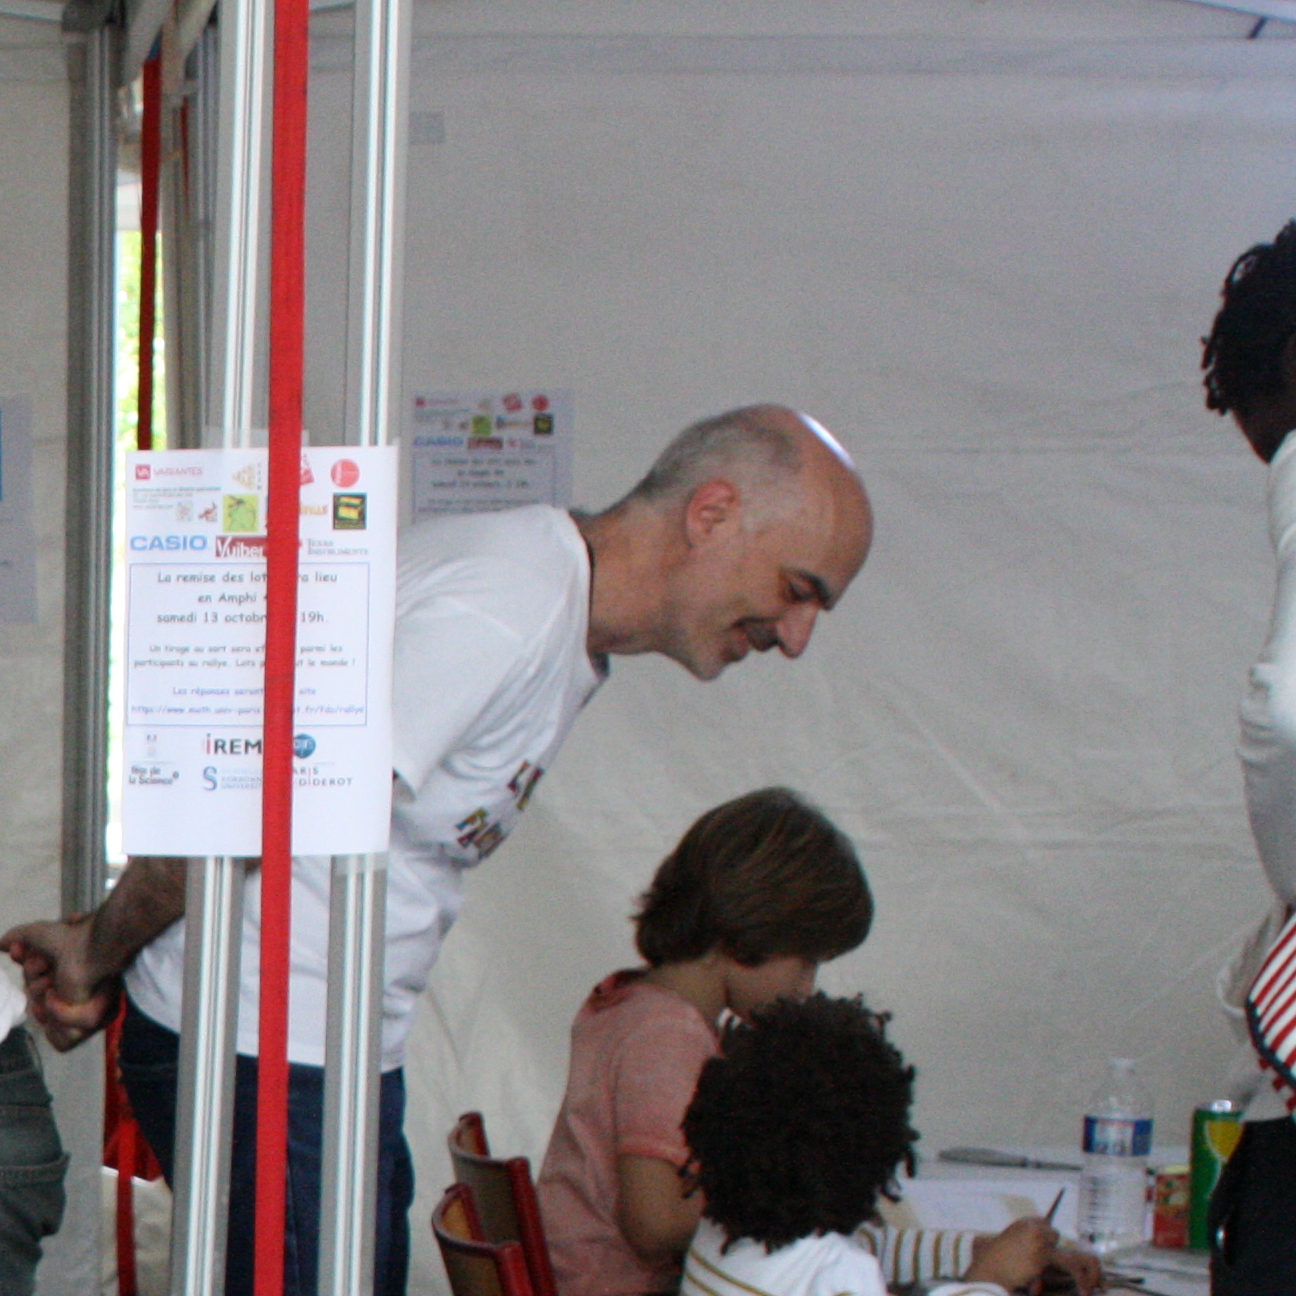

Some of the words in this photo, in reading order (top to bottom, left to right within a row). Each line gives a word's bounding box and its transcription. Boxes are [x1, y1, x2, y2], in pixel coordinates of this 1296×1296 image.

[130, 535, 208, 552] CASIO
[216, 536, 268, 558] Vuiber
[157, 571, 172, 584] La
[176, 571, 216, 583] remise
[222, 571, 244, 583] des
[250, 571, 268, 583] lot
[315, 571, 338, 583] lieu
[197, 593, 213, 603] en
[218, 591, 257, 606] Amphi
[157, 611, 197, 623] samedi
[203, 611, 219, 623] 13
[224, 611, 268, 623] octobr
[298, 776, 354, 787] DIDEROT
